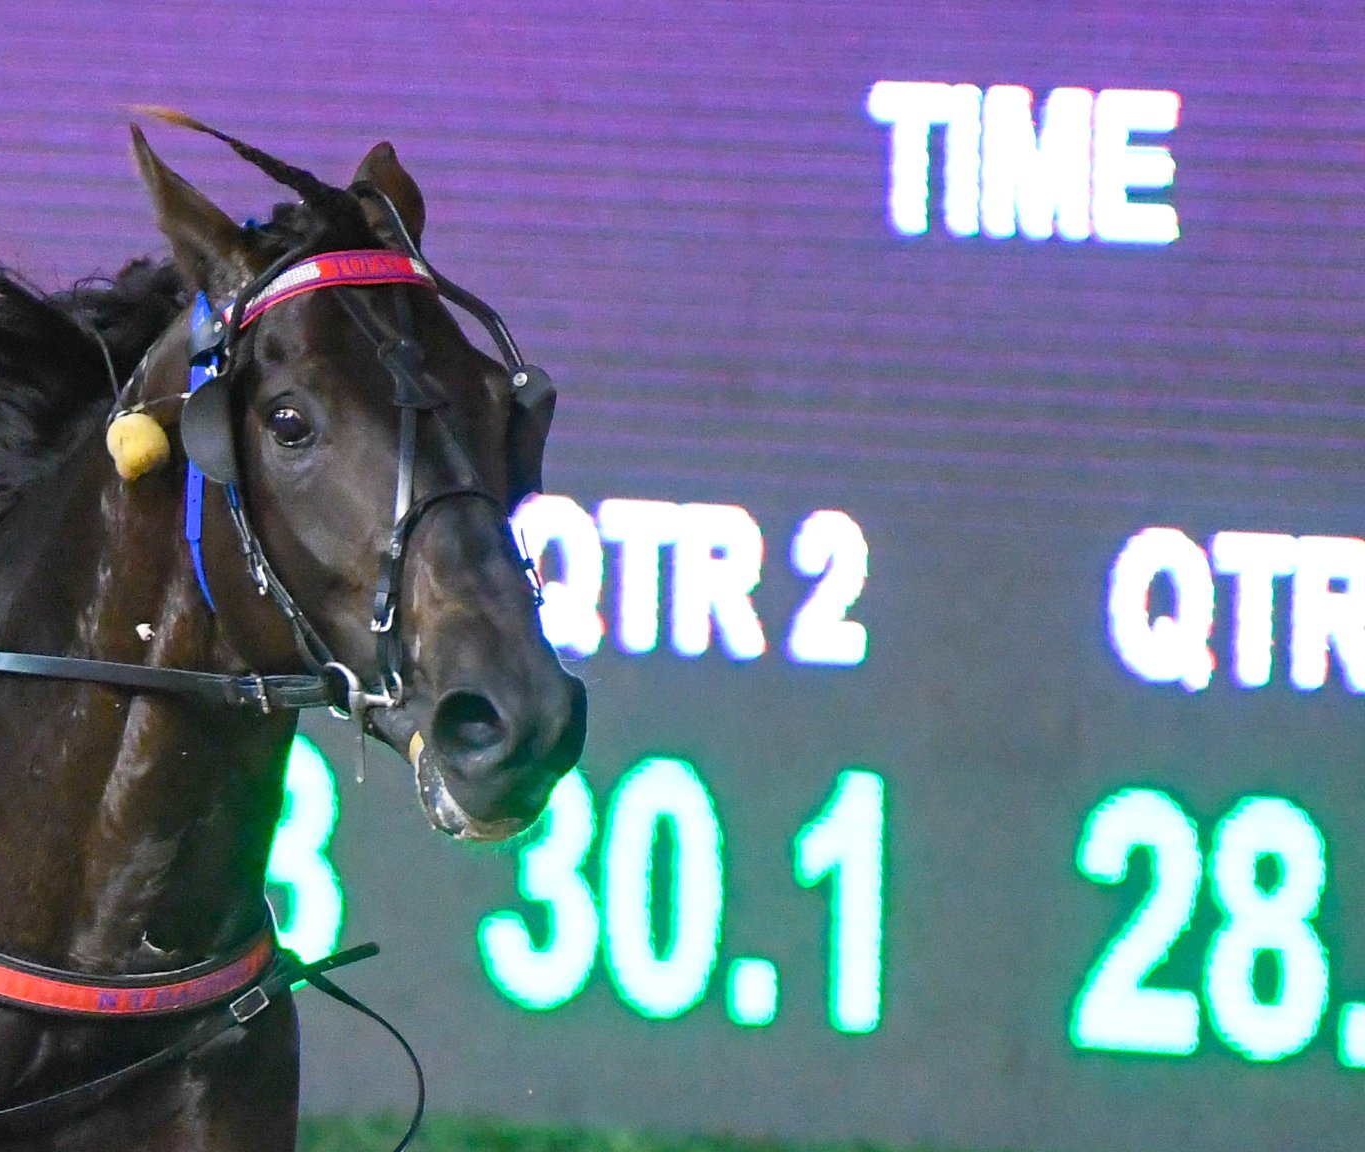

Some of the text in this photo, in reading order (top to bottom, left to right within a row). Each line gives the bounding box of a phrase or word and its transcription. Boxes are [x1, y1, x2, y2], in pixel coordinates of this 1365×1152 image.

[870, 80, 1180, 243] TIME
[509, 494, 869, 664] QTR 2
[1107, 526, 1364, 691] QTR
[478, 757, 886, 1033] 30.1
